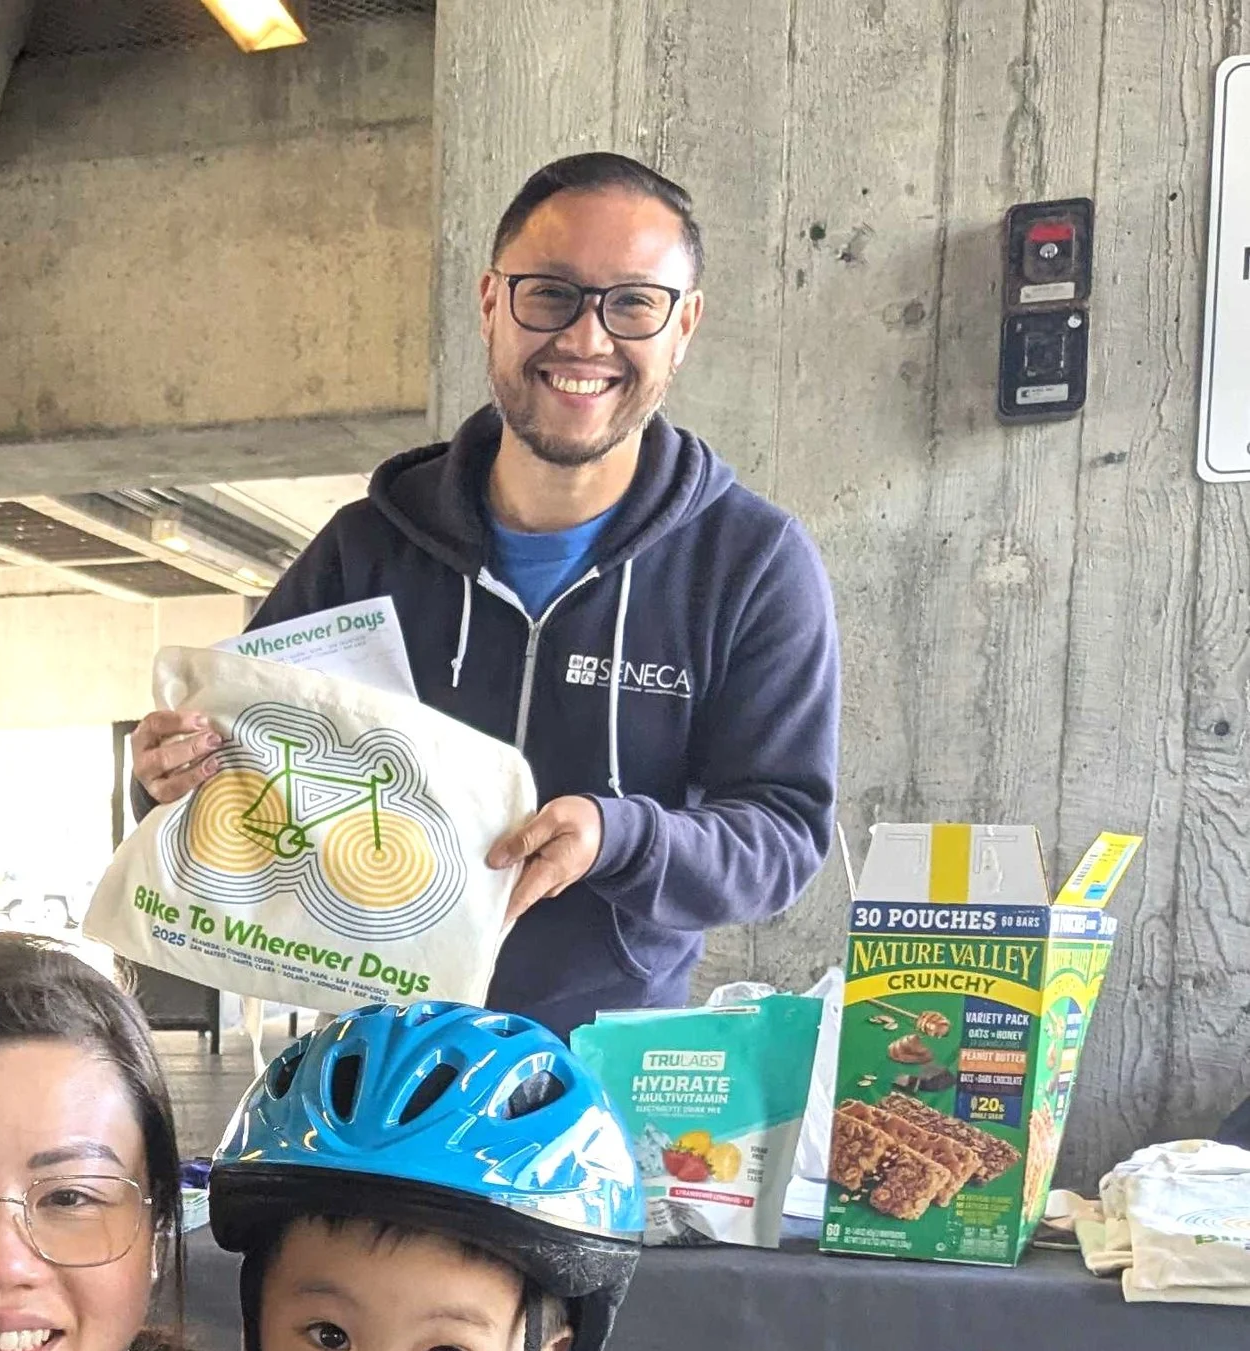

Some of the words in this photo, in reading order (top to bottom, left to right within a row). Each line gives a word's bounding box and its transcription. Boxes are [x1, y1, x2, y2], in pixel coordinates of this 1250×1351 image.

[238, 624, 333, 657] Wherever
[336, 610, 385, 633] Days
[855, 907, 882, 927] 30
[887, 908, 996, 930] POUCHES
[1001, 916, 1013, 927] 60
[1016, 916, 1040, 928] BARS
[134, 885, 180, 924] Bike
[188, 904, 215, 935] To
[224, 915, 353, 972] Wherever
[357, 952, 430, 996] Days
[151, 924, 187, 948] 2025
[852, 940, 945, 975] NATURE
[950, 944, 1037, 981] VALLEY
[351, 981, 390, 996] FRANCISCO
[888, 973, 996, 994] CRUNCHY
[966, 1011, 1003, 1025] VARIETY
[1005, 1014, 1030, 1026] PACK
[968, 1028, 989, 1039] OATS
[996, 1030, 1023, 1040] HONEY
[649, 1054, 719, 1067] TRULABS
[961, 1049, 994, 1061] PEANUT
[632, 1076, 731, 1093] HYDRATE
[639, 1092, 728, 1104] MULTIVITAMIN
